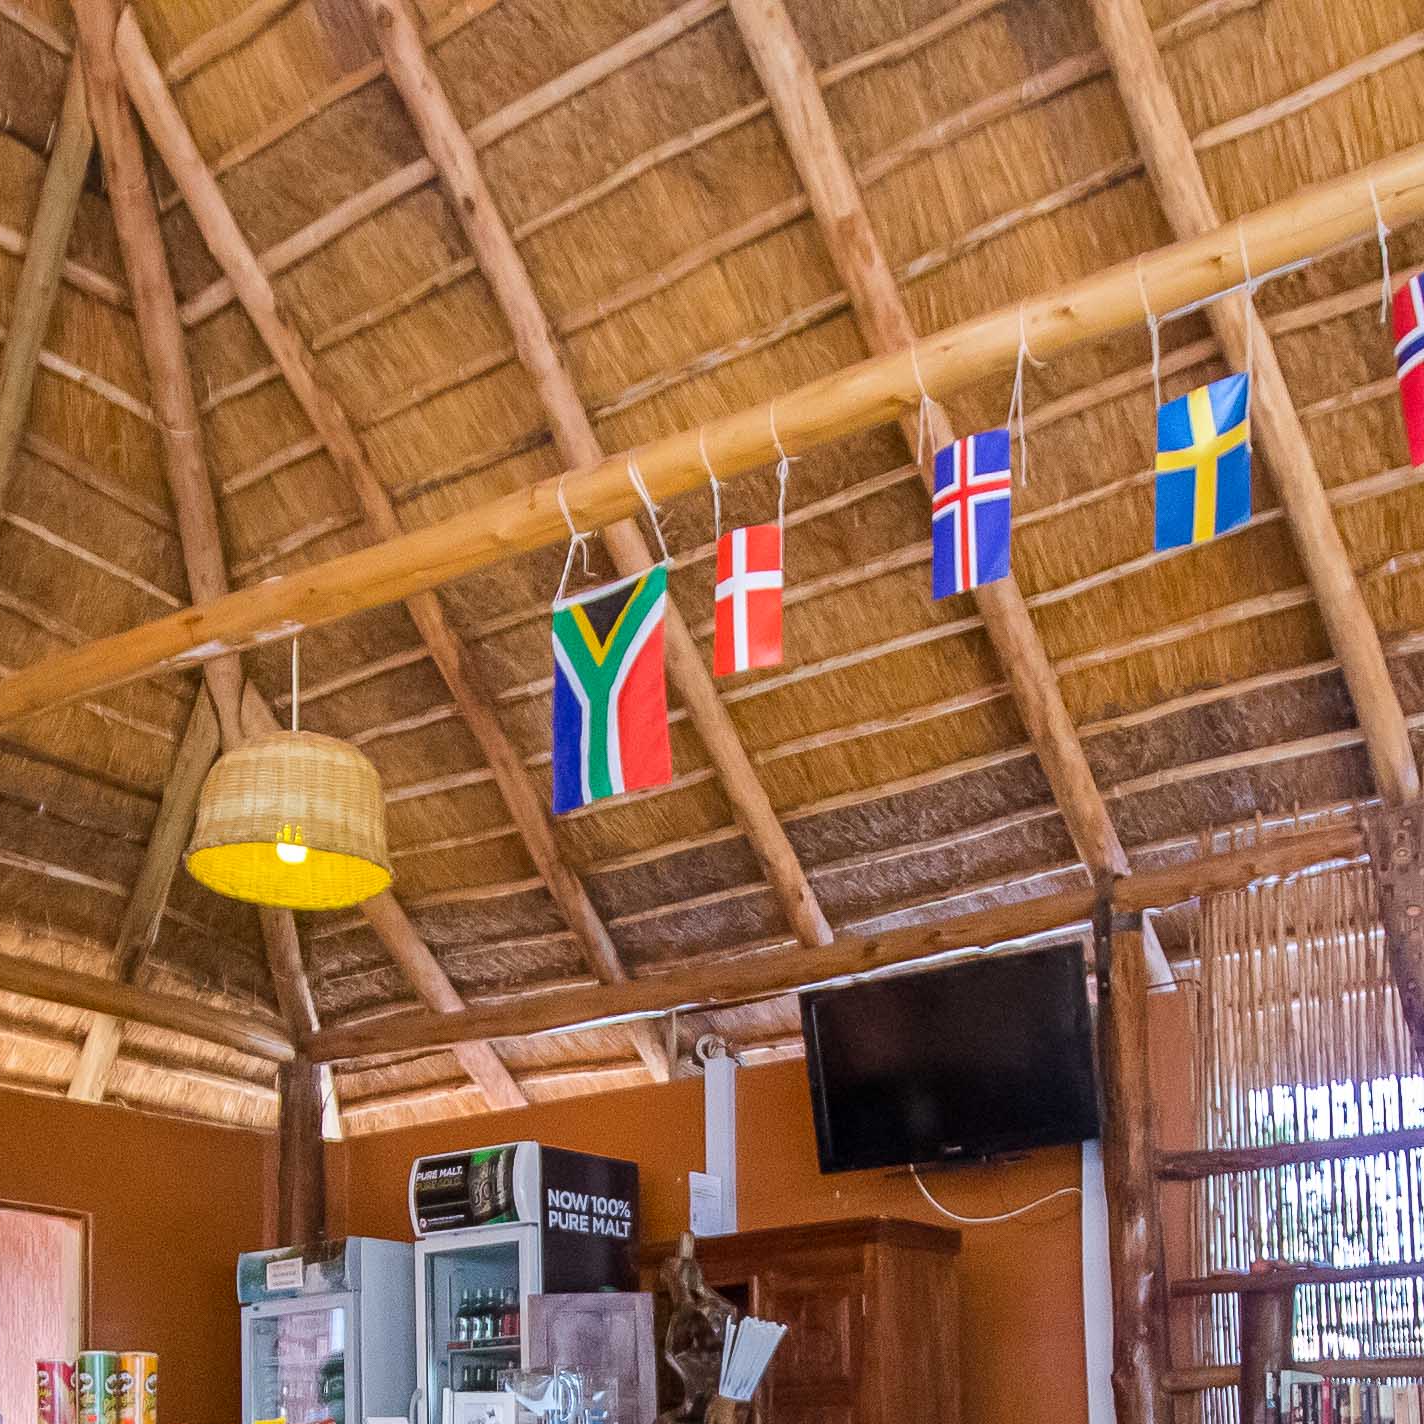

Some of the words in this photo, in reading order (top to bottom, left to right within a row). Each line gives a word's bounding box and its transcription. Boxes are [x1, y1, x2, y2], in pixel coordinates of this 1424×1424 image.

[416, 1170, 438, 1181] PURE
[547, 1188, 589, 1213] NOW
[590, 1195, 631, 1218] 100%
[548, 1210, 589, 1233] PURE
[592, 1216, 631, 1238] MALT
